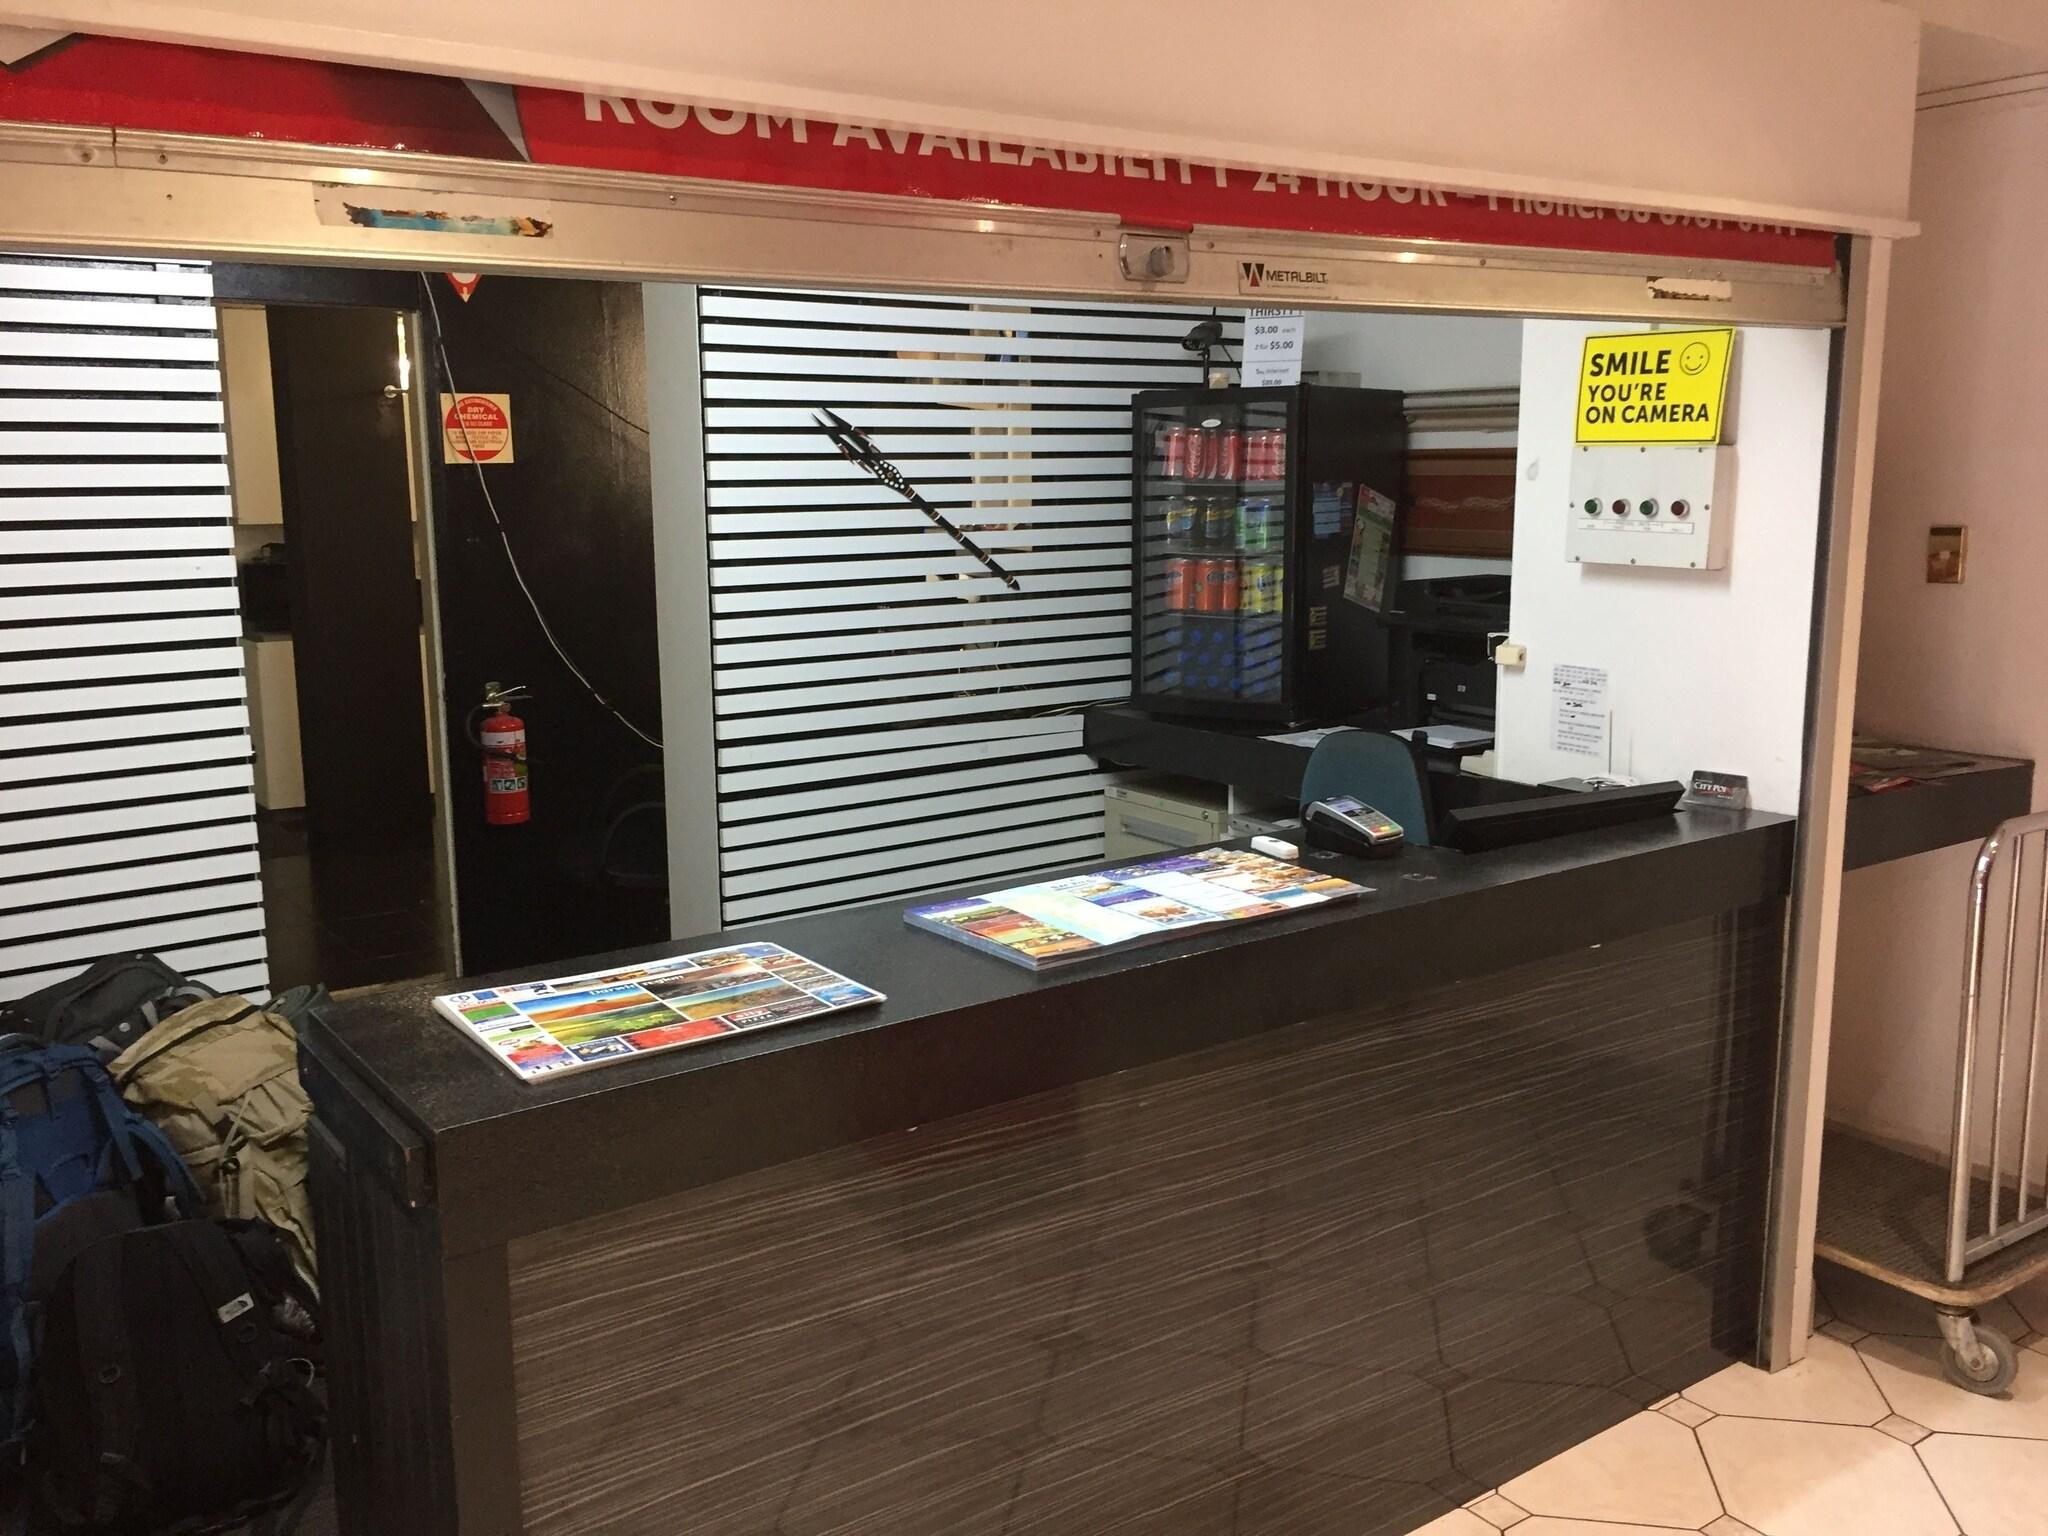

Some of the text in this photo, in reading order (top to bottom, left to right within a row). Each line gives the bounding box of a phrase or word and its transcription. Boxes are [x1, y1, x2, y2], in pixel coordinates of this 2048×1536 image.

[584, 92, 808, 144] ROOM
[1266, 270, 1327, 283] METALBILT
[1254, 325, 1279, 335] $3.00
[1270, 340, 1294, 351] $5.00
[1589, 350, 1672, 377] SMILE
[1588, 382, 1667, 403] YOU'RE
[454, 413, 499, 421] CHEMICAL
[1585, 403, 1709, 424] ON CAMERA
